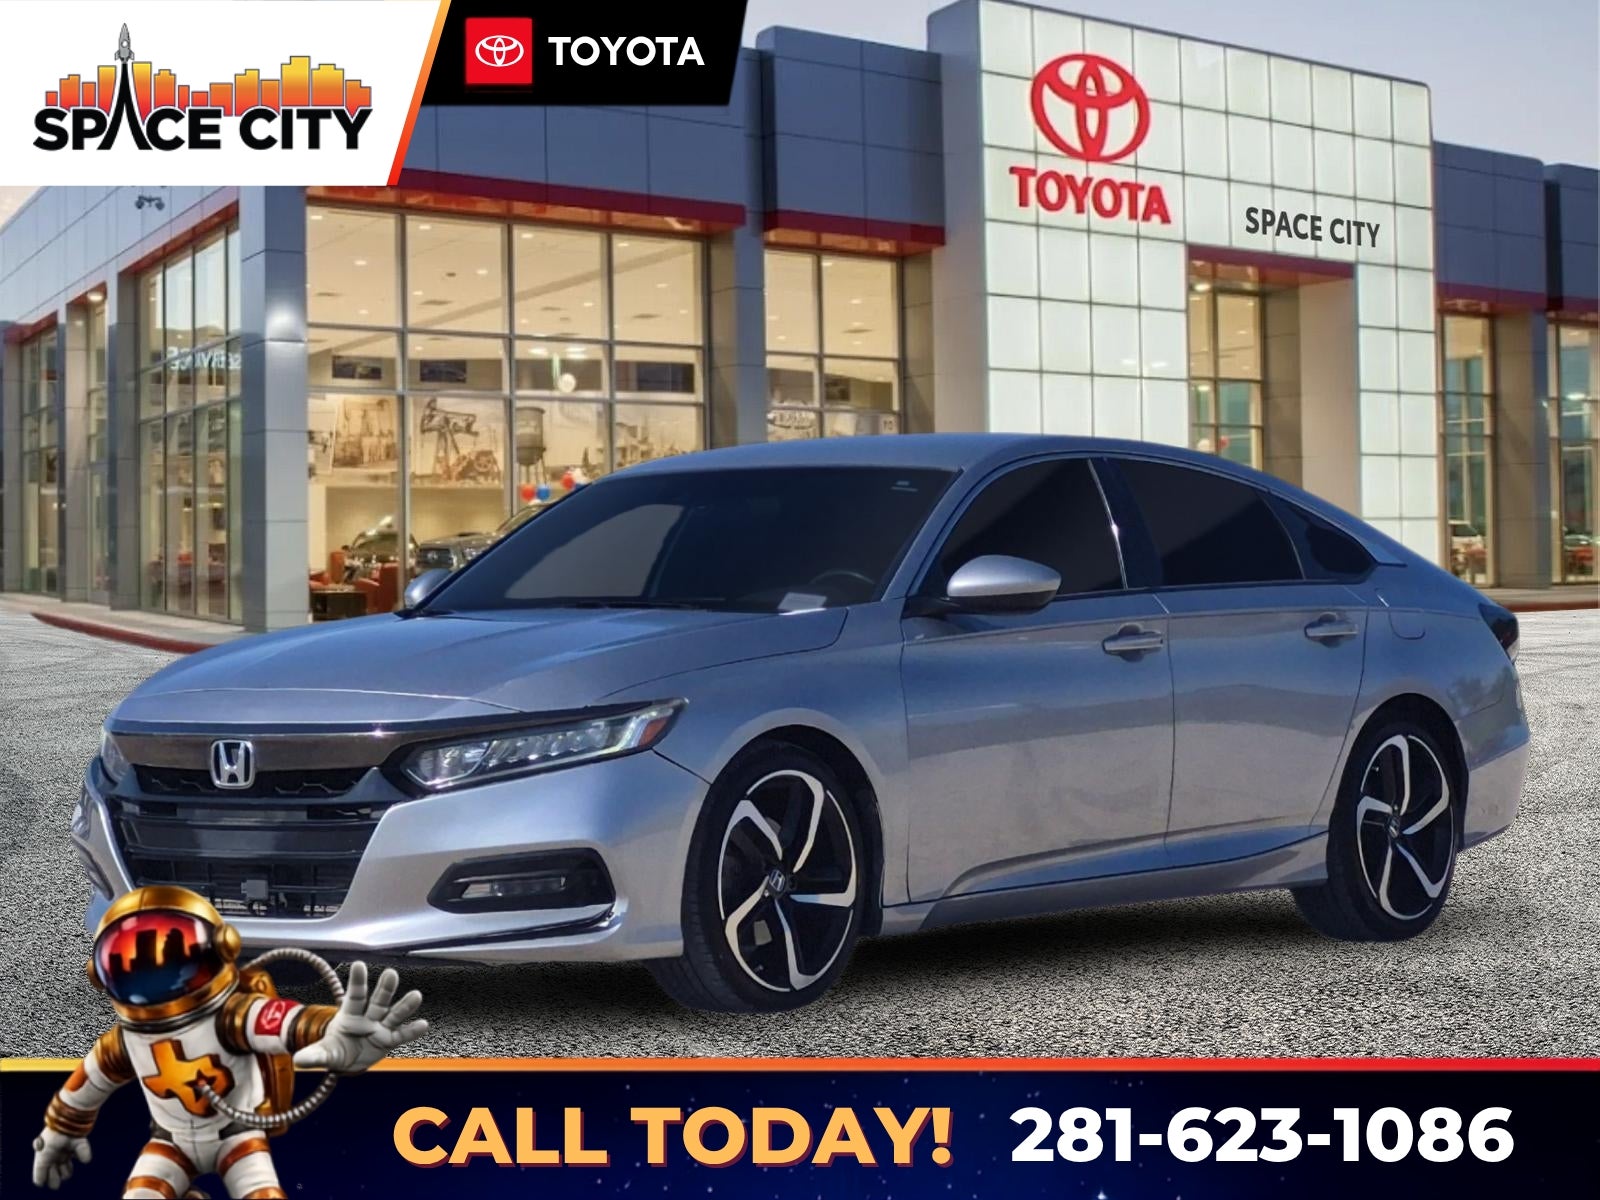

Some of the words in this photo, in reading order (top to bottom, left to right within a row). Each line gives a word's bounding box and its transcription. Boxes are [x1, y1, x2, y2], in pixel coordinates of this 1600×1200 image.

[1009, 166, 1171, 224] TOYOTA
[1245, 206, 1321, 241] SPACE
[1330, 217, 1381, 248] CITY
